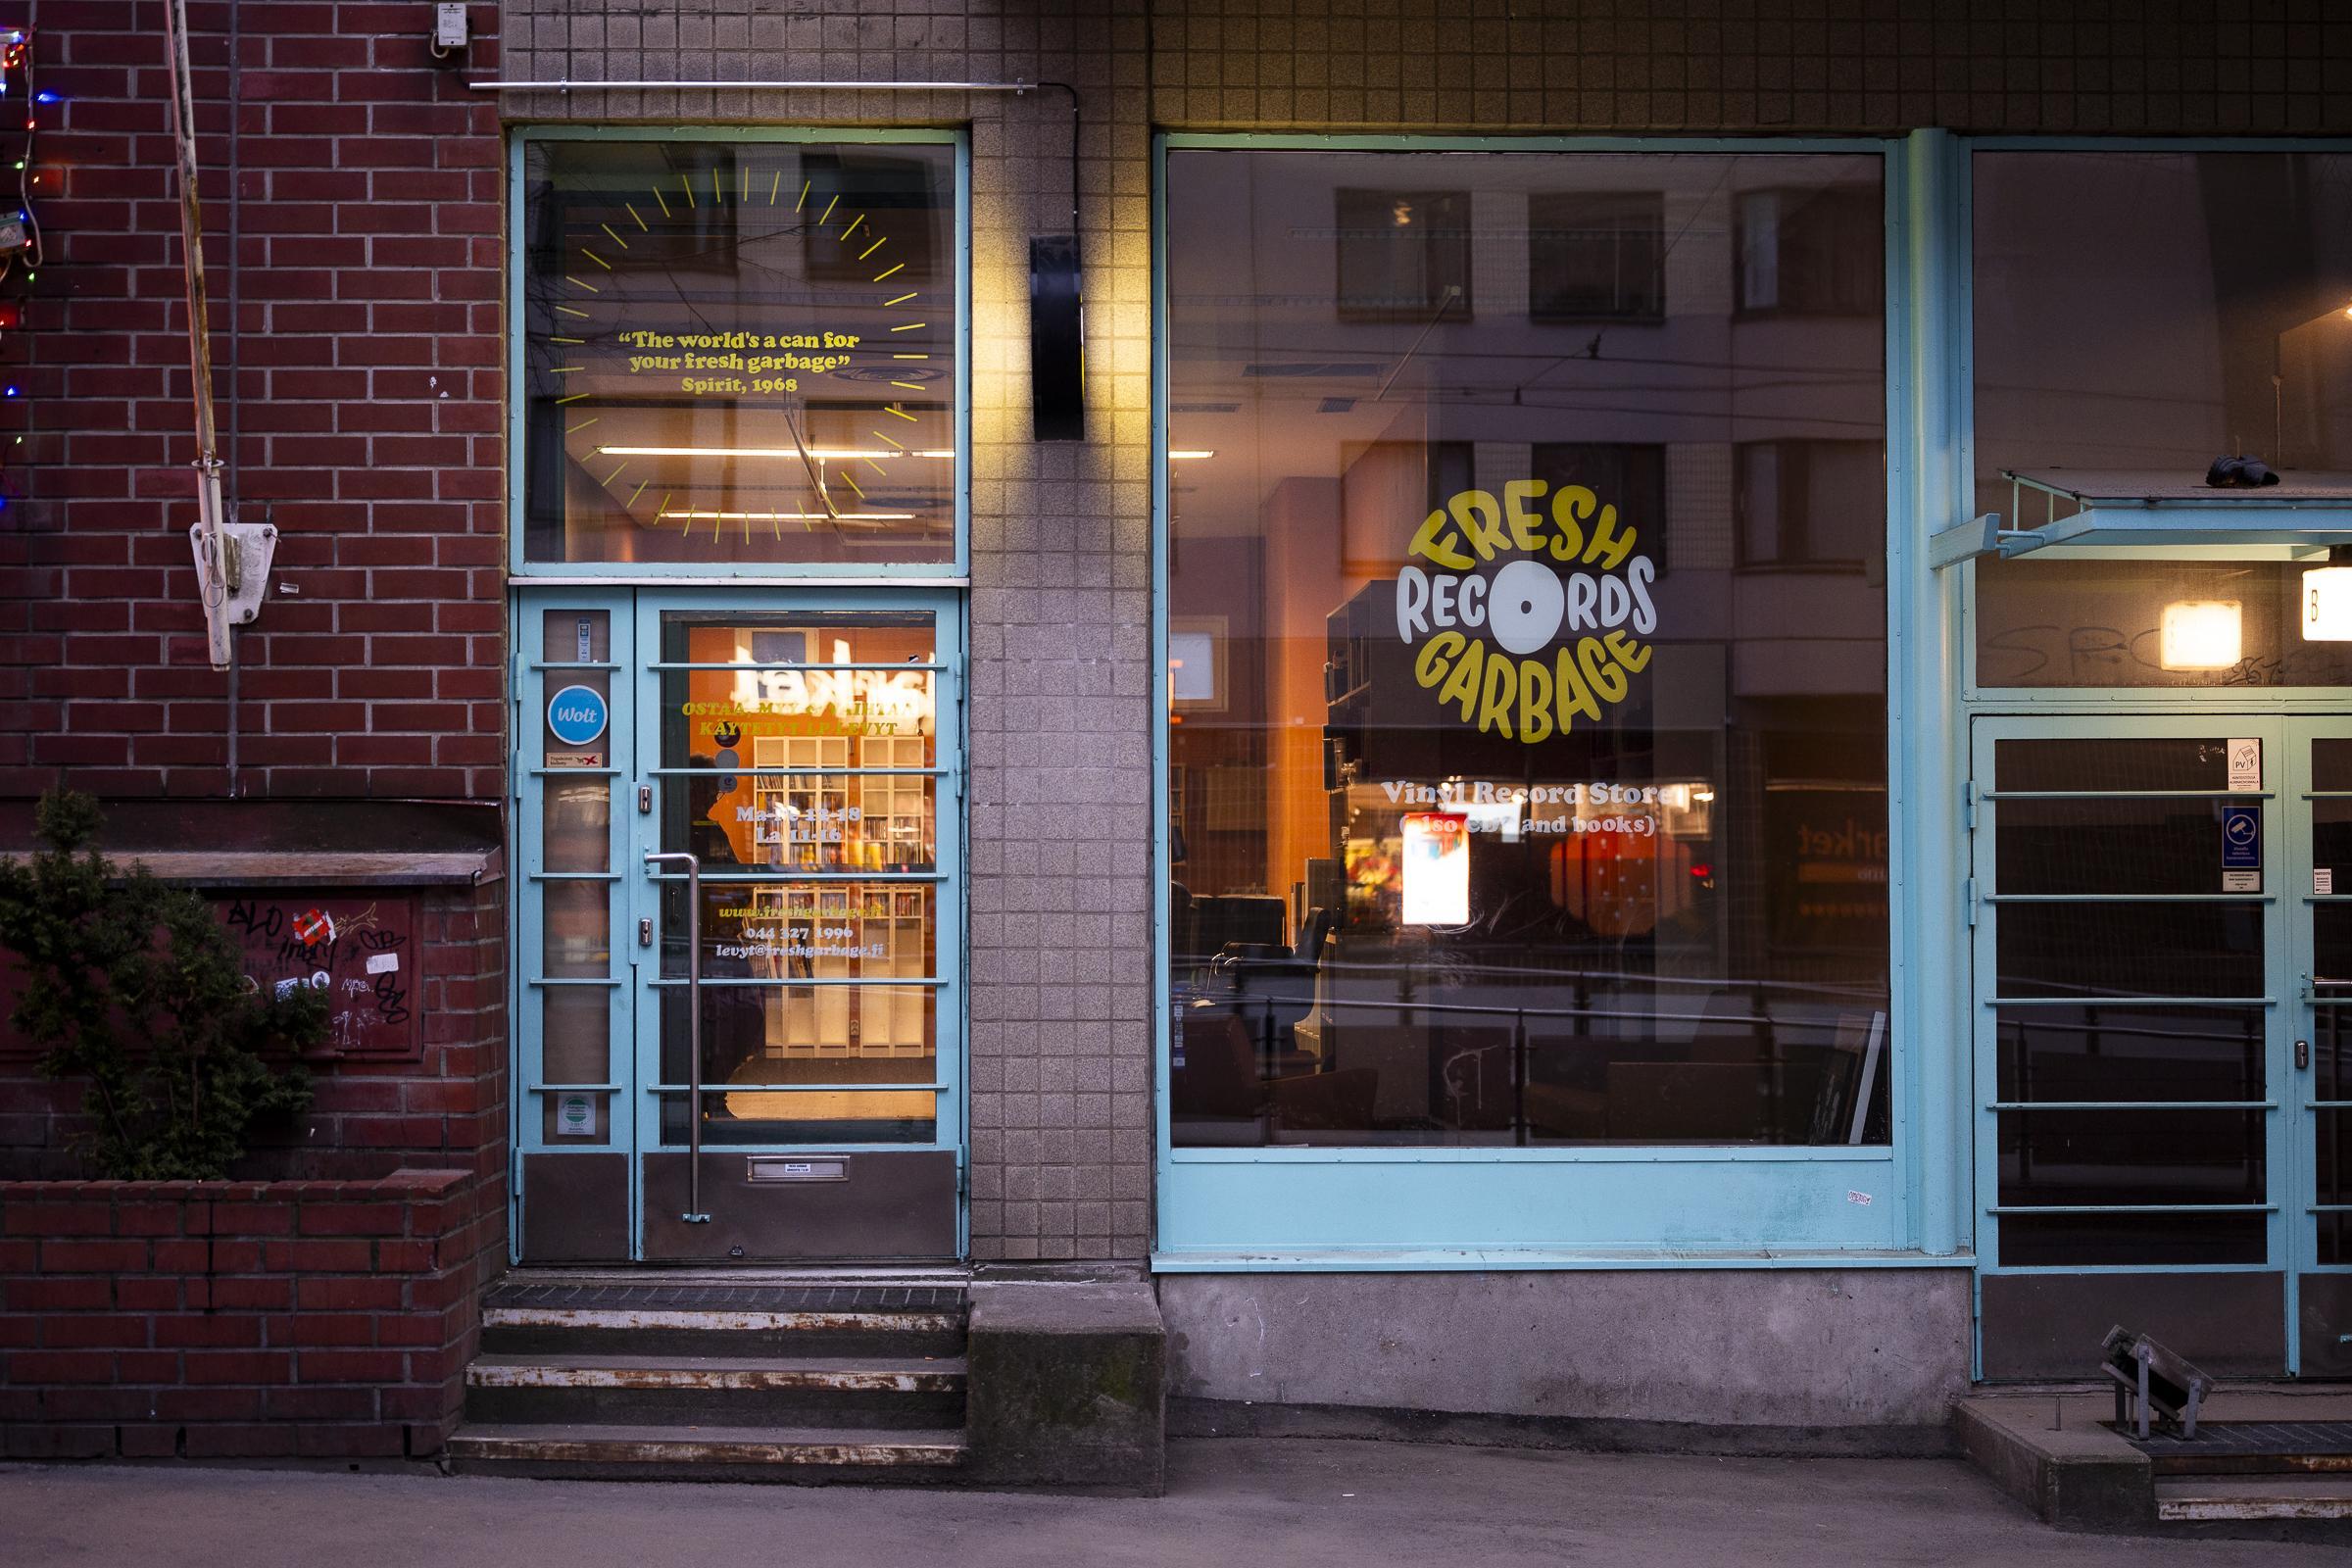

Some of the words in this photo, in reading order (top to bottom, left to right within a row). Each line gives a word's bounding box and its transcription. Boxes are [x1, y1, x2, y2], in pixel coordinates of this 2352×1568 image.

[676, 331, 760, 349] world's
[763, 335, 777, 348] a
[779, 335, 819, 348] can
[823, 331, 860, 349] for
[628, 356, 682, 373] your
[684, 353, 744, 369] fresh
[747, 353, 851, 374] garbage”
[681, 377, 747, 395] Spirit,
[752, 377, 799, 393] 1968
[1407, 478, 1639, 570] FRESH
[1396, 555, 1658, 655] RECORDS
[2311, 589, 2319, 622] B
[1414, 628, 1653, 745] GARBAGE
[558, 707, 598, 723] Wolt
[758, 702, 801, 715] MYY
[2235, 760, 2246, 769] PV
[1380, 781, 1466, 810] Vinyl
[1473, 782, 1585, 805] Record
[1589, 782, 1678, 805] Store
[756, 827, 781, 841] La
[1398, 815, 1458, 835] (lso
[1521, 815, 1567, 833] and
[1571, 815, 1657, 837] books)
[746, 927, 775, 940] 044
[815, 927, 854, 940] 1996
